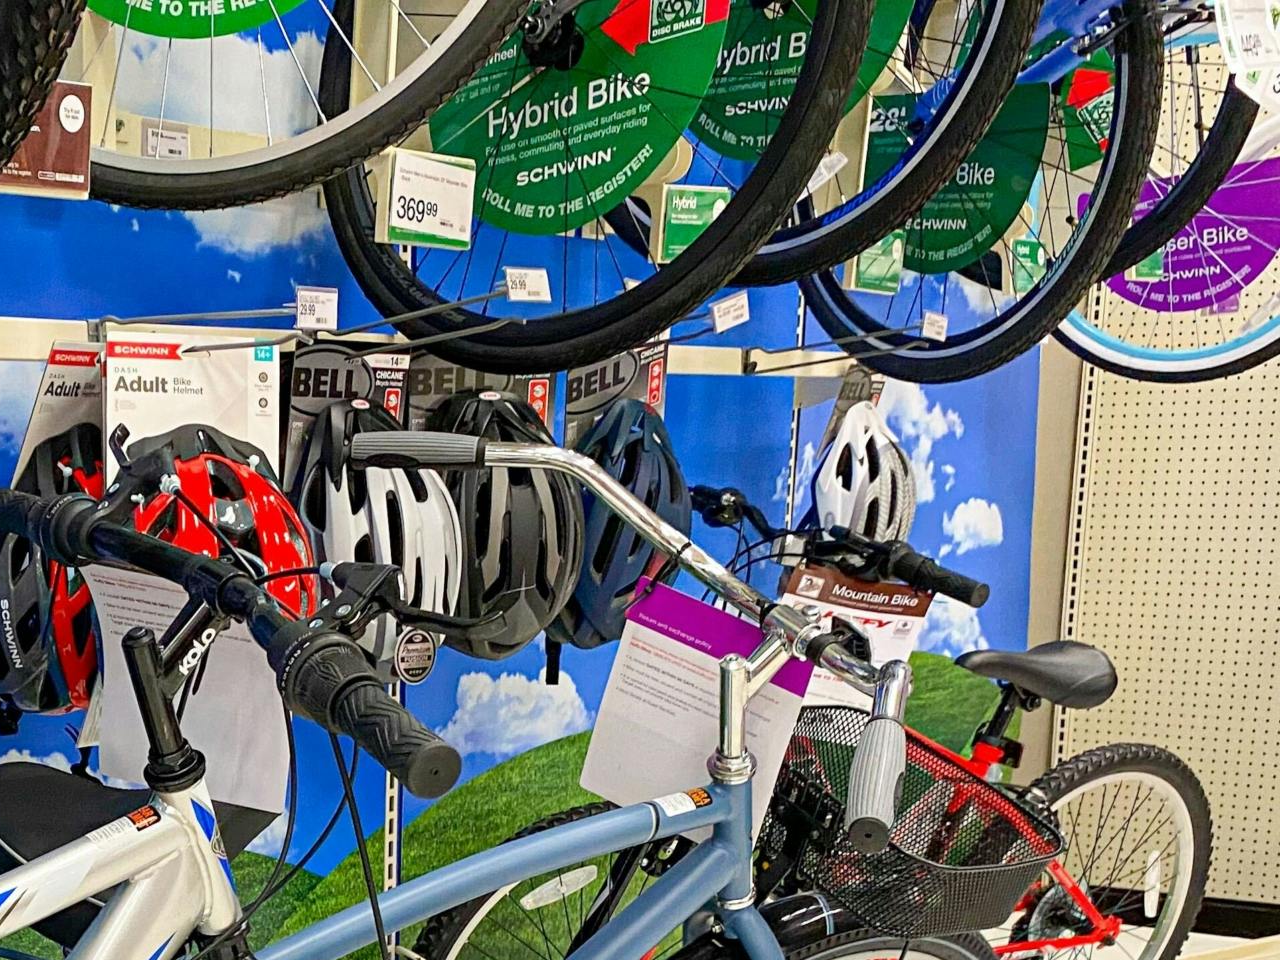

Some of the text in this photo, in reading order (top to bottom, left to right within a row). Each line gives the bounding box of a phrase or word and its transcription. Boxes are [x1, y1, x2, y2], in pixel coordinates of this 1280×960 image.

[159, 0, 183, 17] TO
[189, 1, 225, 17] THE
[652, 16, 702, 38] DISC BRAKE
[487, 72, 651, 140] Hybrid Bike
[725, 95, 791, 116] SCHWIN
[501, 102, 652, 153] use on smooth paved surfaces for
[519, 115, 648, 160] commuting everyday riding
[516, 147, 612, 187] SCHWINN
[955, 162, 995, 186] Bike
[481, 143, 654, 219] ROLL ME TO THE REGISTER!
[672, 195, 697, 212] Hybrid
[1203, 225, 1249, 247] Bike
[1160, 265, 1221, 282] CHWINN
[510, 279, 527, 291] 29.99
[1182, 291, 1202, 302] THE
[299, 303, 316, 316] 29.99
[54, 352, 91, 363] SCHWINN
[113, 345, 170, 356] SCHWINN
[256, 350, 271, 360] 14+
[114, 375, 192, 394] Adult Bike
[292, 367, 358, 399] BELL
[375, 371, 405, 381] CHICANE
[409, 367, 493, 395] BELL
[567, 360, 626, 402] BELL
[43, 380, 82, 397] Adult
[172, 385, 204, 396] Helmet
[831, 583, 890, 605] Mountain
[890, 595, 919, 608] Bike
[0, 598, 23, 669] SCHWINN
